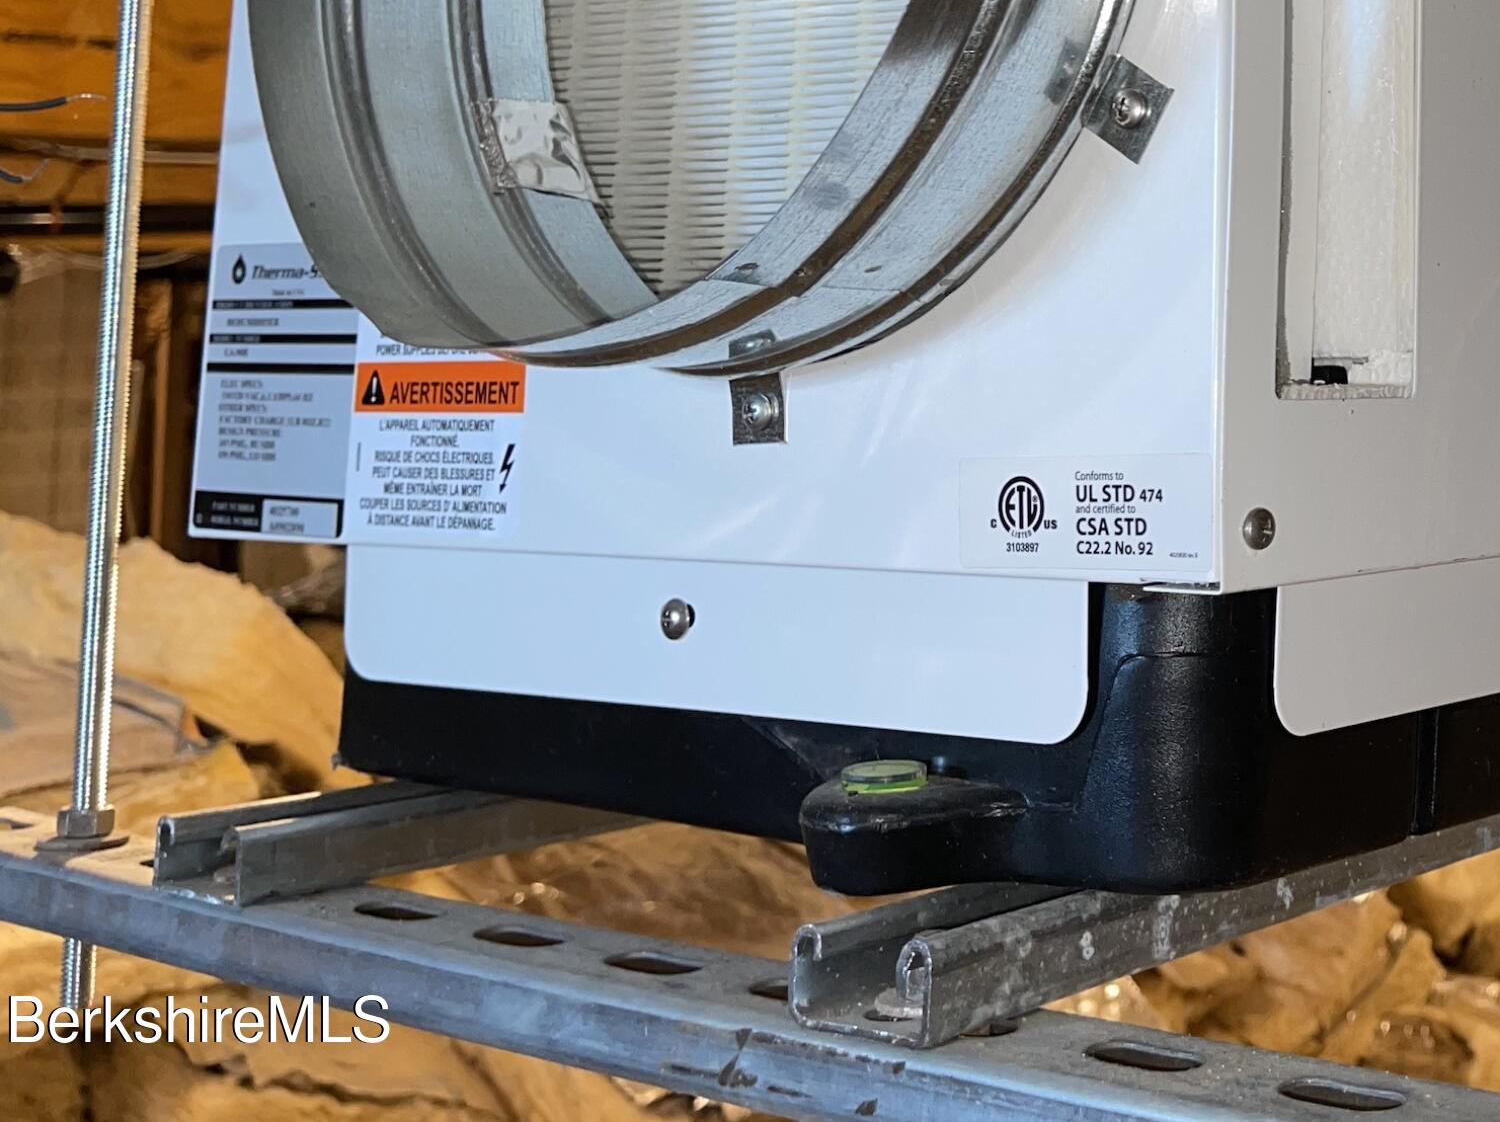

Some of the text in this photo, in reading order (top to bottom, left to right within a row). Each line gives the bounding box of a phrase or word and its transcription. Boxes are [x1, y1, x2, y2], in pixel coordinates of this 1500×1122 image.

[252, 264, 321, 279] Therma-S
[376, 344, 400, 355] POWER
[389, 381, 519, 405] AVERTISSEMENT
[379, 419, 495, 432] L'APPAREIL AUTOMATIQUEMENT
[374, 450, 400, 463] RISQUE
[402, 451, 413, 463] DE
[415, 451, 440, 463] CHOCS
[372, 466, 496, 481] PEUT CAUSER DES BLESSURES ET
[1074, 470, 1124, 481] Conforms to
[450, 484, 459, 496] LA
[461, 485, 482, 496] MORT
[1076, 484, 1163, 503] UL STD 474
[359, 497, 389, 510] COUPER
[391, 498, 405, 510] LES
[407, 499, 442, 512] SOURCES
[452, 501, 507, 514] ALIMENTATION
[1075, 503, 1136, 514] and certified to
[374, 513, 409, 526] DISTANCE
[411, 515, 435, 527] AVANT
[436, 516, 446, 528] LE
[1043, 519, 1058, 529] US
[1076, 517, 1147, 536] CSA STD
[1011, 529, 1032, 539] LISTED
[1006, 542, 1039, 553] 3103897
[1076, 540, 1111, 555] C22.2
[1115, 541, 1136, 555] No.
[1138, 542, 1153, 555] 92
